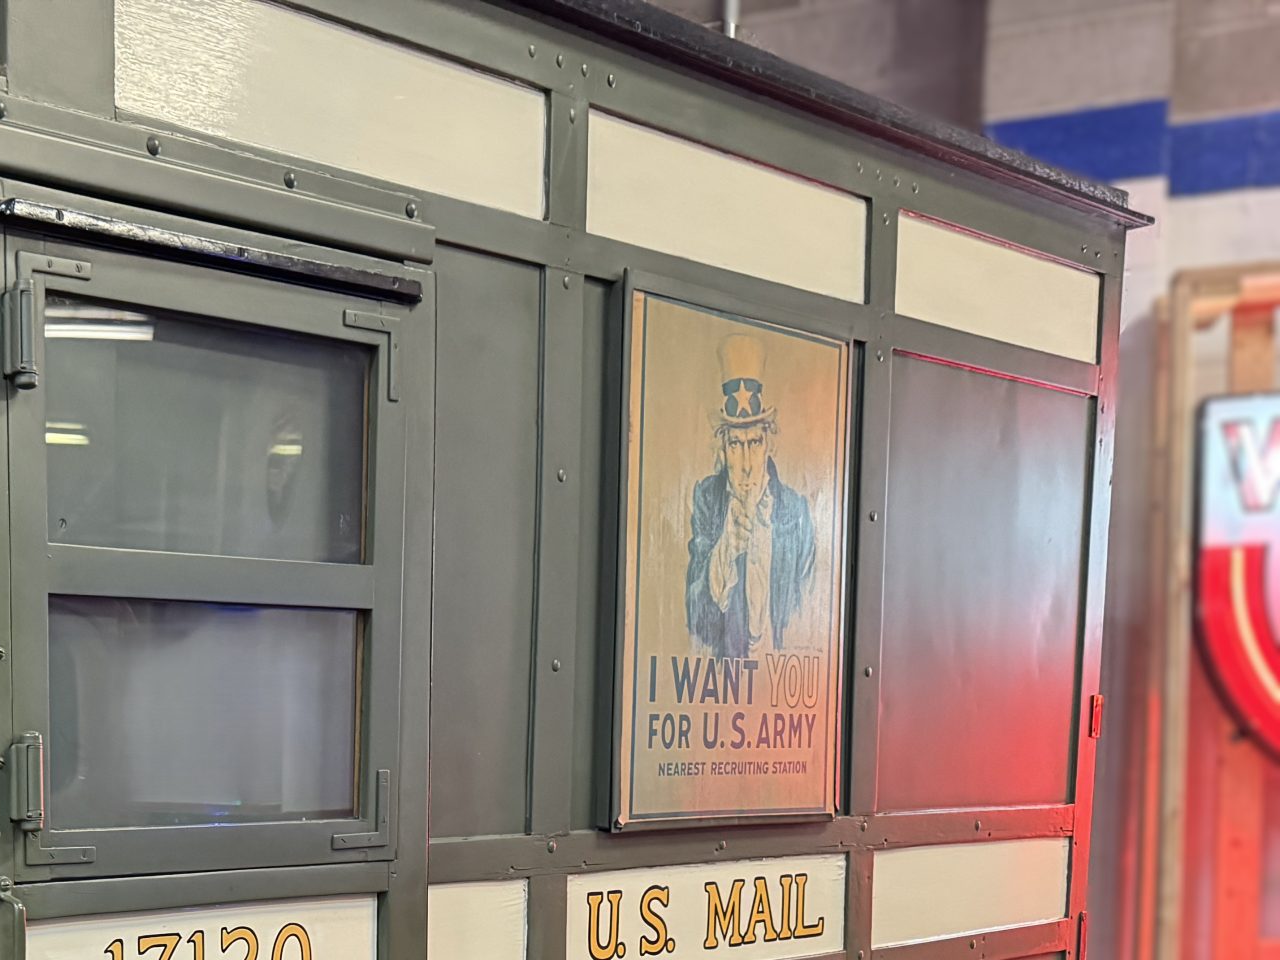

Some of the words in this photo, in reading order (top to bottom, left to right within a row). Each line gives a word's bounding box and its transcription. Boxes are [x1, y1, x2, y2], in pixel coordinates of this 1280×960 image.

[649, 655, 657, 703] I
[671, 656, 759, 705] WANT
[765, 653, 820, 709] YOU
[648, 712, 692, 749] FOR
[658, 761, 706, 777] NEAREST
[710, 761, 769, 776] RECRUITING
[771, 760, 808, 775] STATION
[703, 873, 825, 950] MAIL
